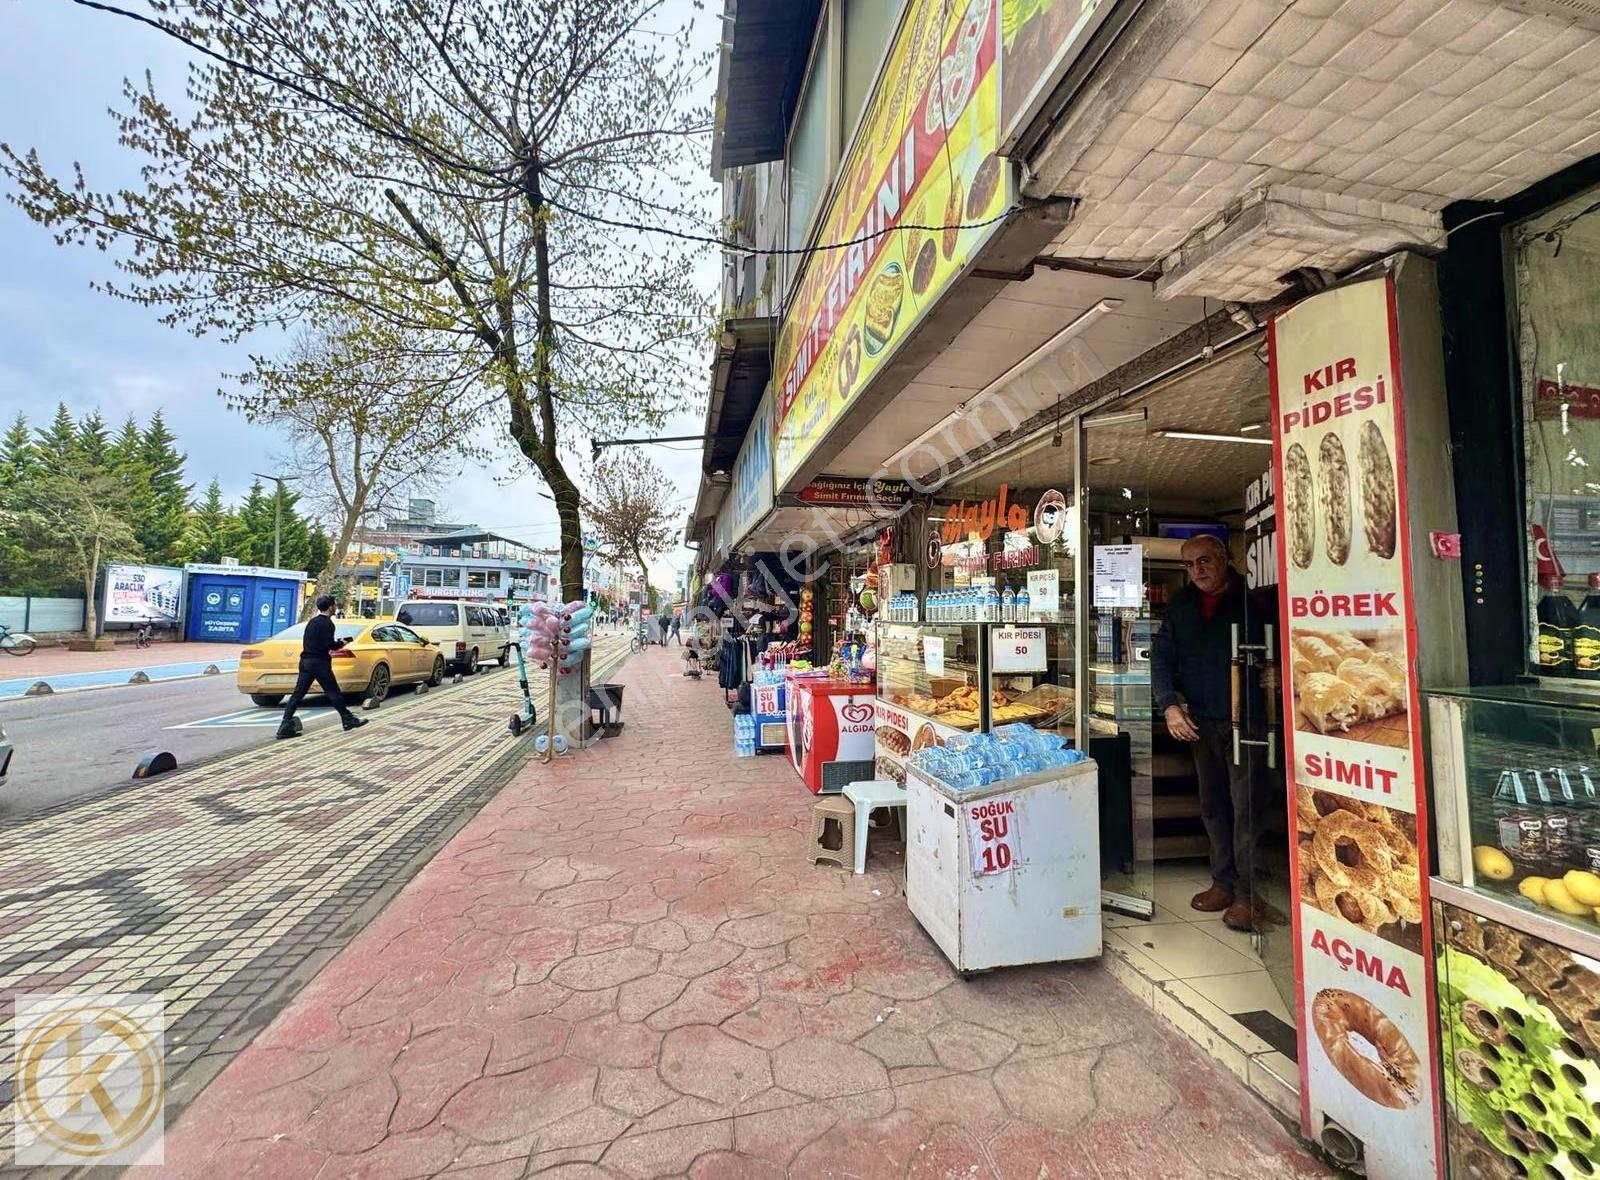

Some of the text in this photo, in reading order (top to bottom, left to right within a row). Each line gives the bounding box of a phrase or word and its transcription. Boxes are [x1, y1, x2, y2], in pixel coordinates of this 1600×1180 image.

[829, 124, 916, 328] FIRINI
[1304, 357, 1357, 395] KIR
[1283, 375, 1387, 434] PİDESİ
[813, 492, 837, 500] Simit
[873, 480, 911, 494] Yayla
[941, 483, 1030, 543] Yayla
[993, 544, 1040, 570] FIRINI
[462, 589, 485, 597] KING
[1291, 589, 1398, 618] BÖREK
[998, 630, 1041, 640] KIR PİDESİ
[1015, 646, 1028, 655] 50
[760, 692, 773, 701] SU
[760, 701, 776, 713] 10
[1304, 751, 1398, 796] SİMİT
[971, 801, 1014, 820] SOĞUK
[980, 815, 1008, 842] SU
[982, 843, 1011, 873] 10
[1310, 928, 1412, 998] AÇMA
